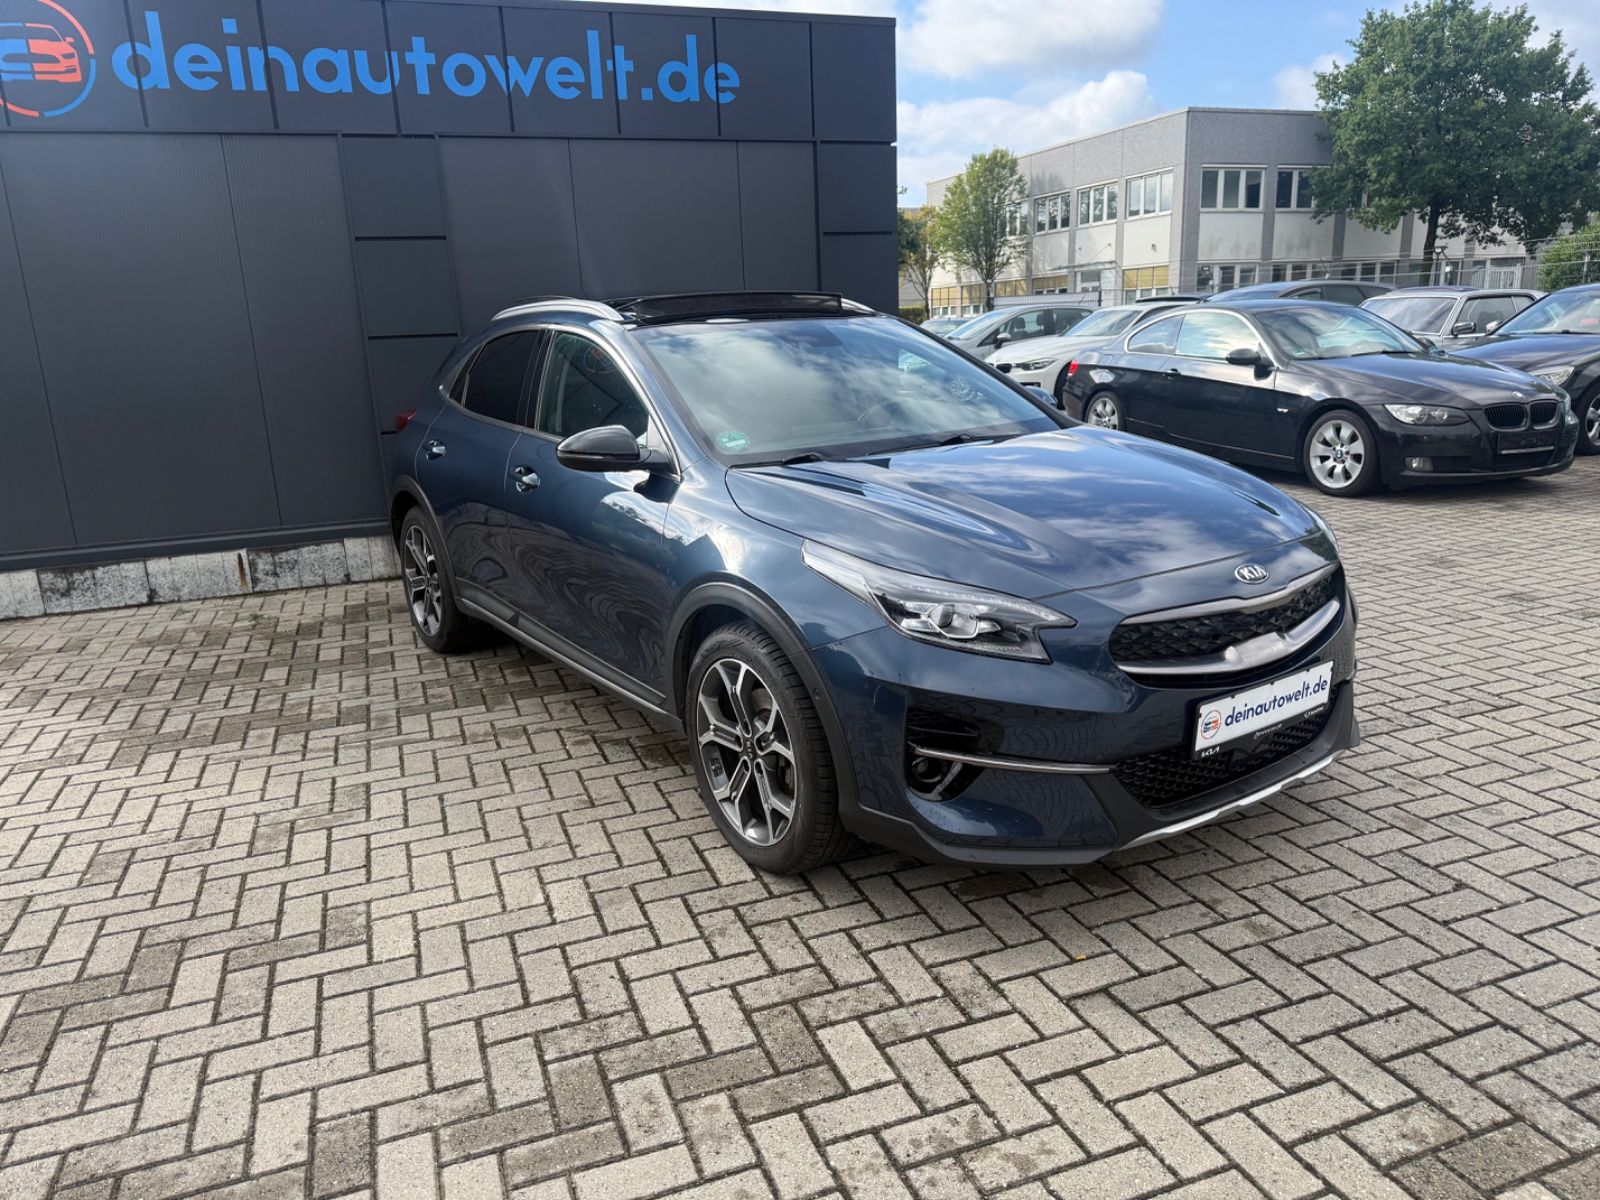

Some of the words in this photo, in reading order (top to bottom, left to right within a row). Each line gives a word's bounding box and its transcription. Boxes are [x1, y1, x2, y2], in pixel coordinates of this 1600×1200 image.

[111, 11, 741, 104] deinautowelt.de
[1239, 565, 1267, 580] KIA
[1224, 675, 1329, 727] deinautowelt.de
